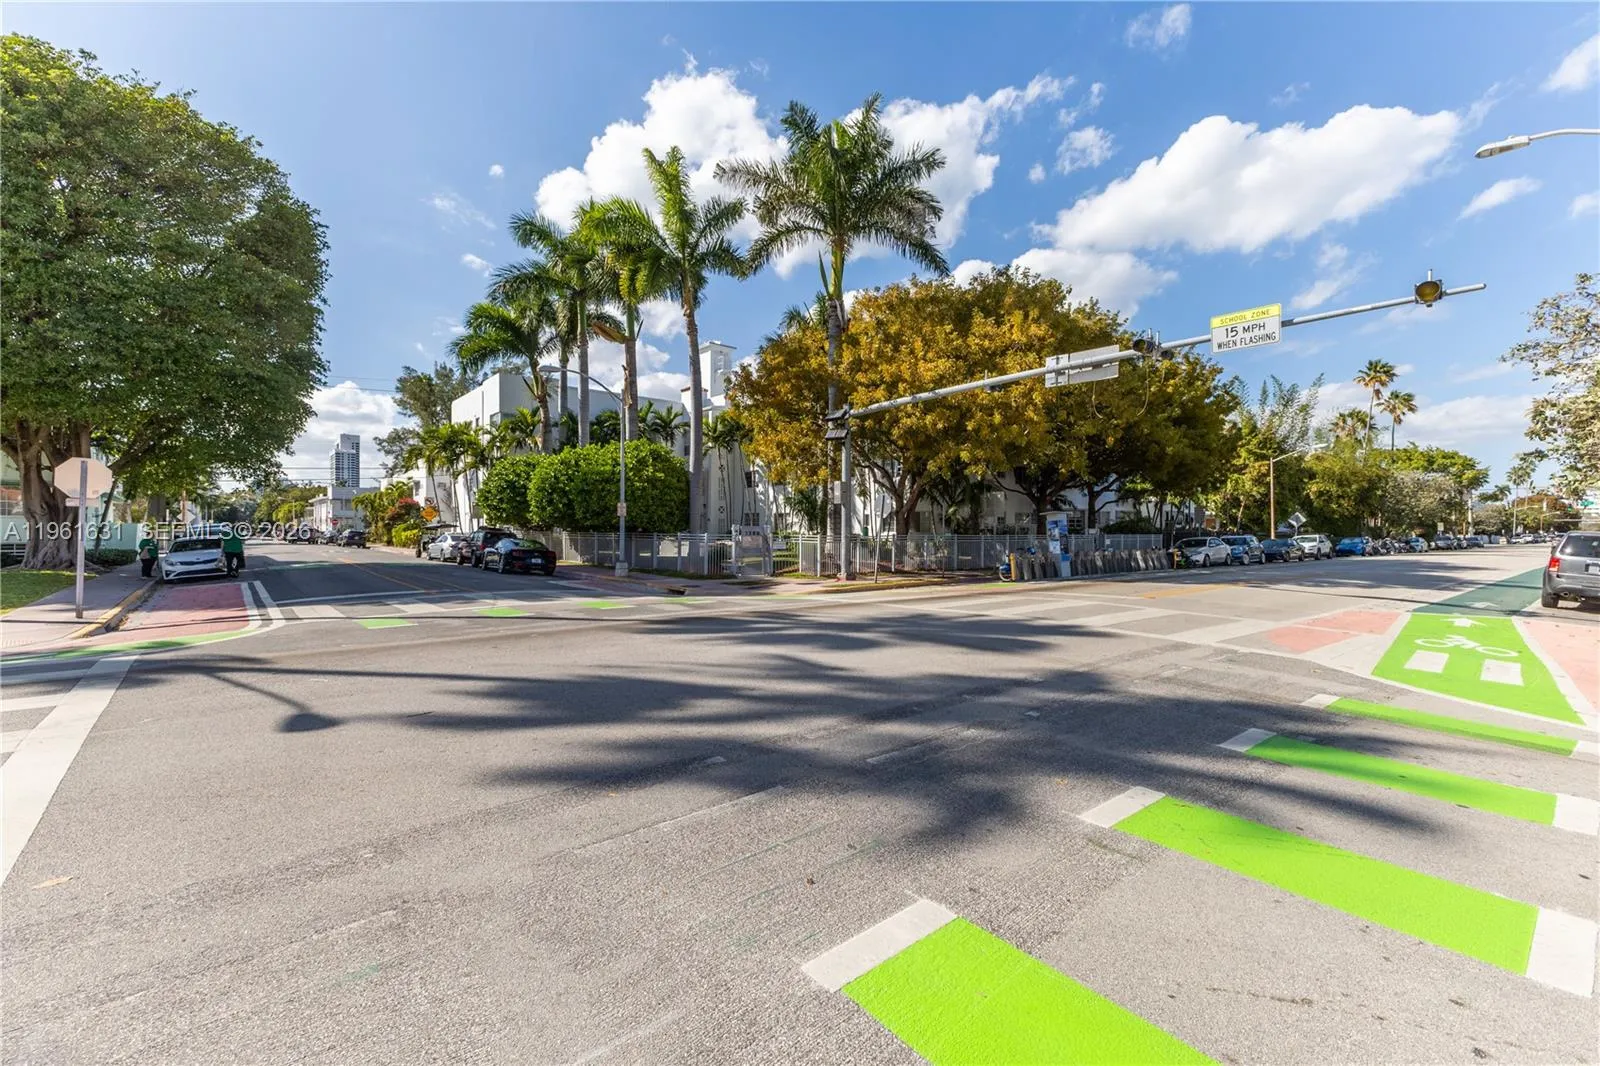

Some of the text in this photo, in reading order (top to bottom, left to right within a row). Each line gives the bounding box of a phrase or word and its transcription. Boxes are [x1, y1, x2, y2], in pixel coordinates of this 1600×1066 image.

[1220, 308, 1270, 325] SCHOOL ZONE
[1225, 322, 1265, 338] 15 MPH
[1217, 332, 1276, 350] WHEN FLASHING
